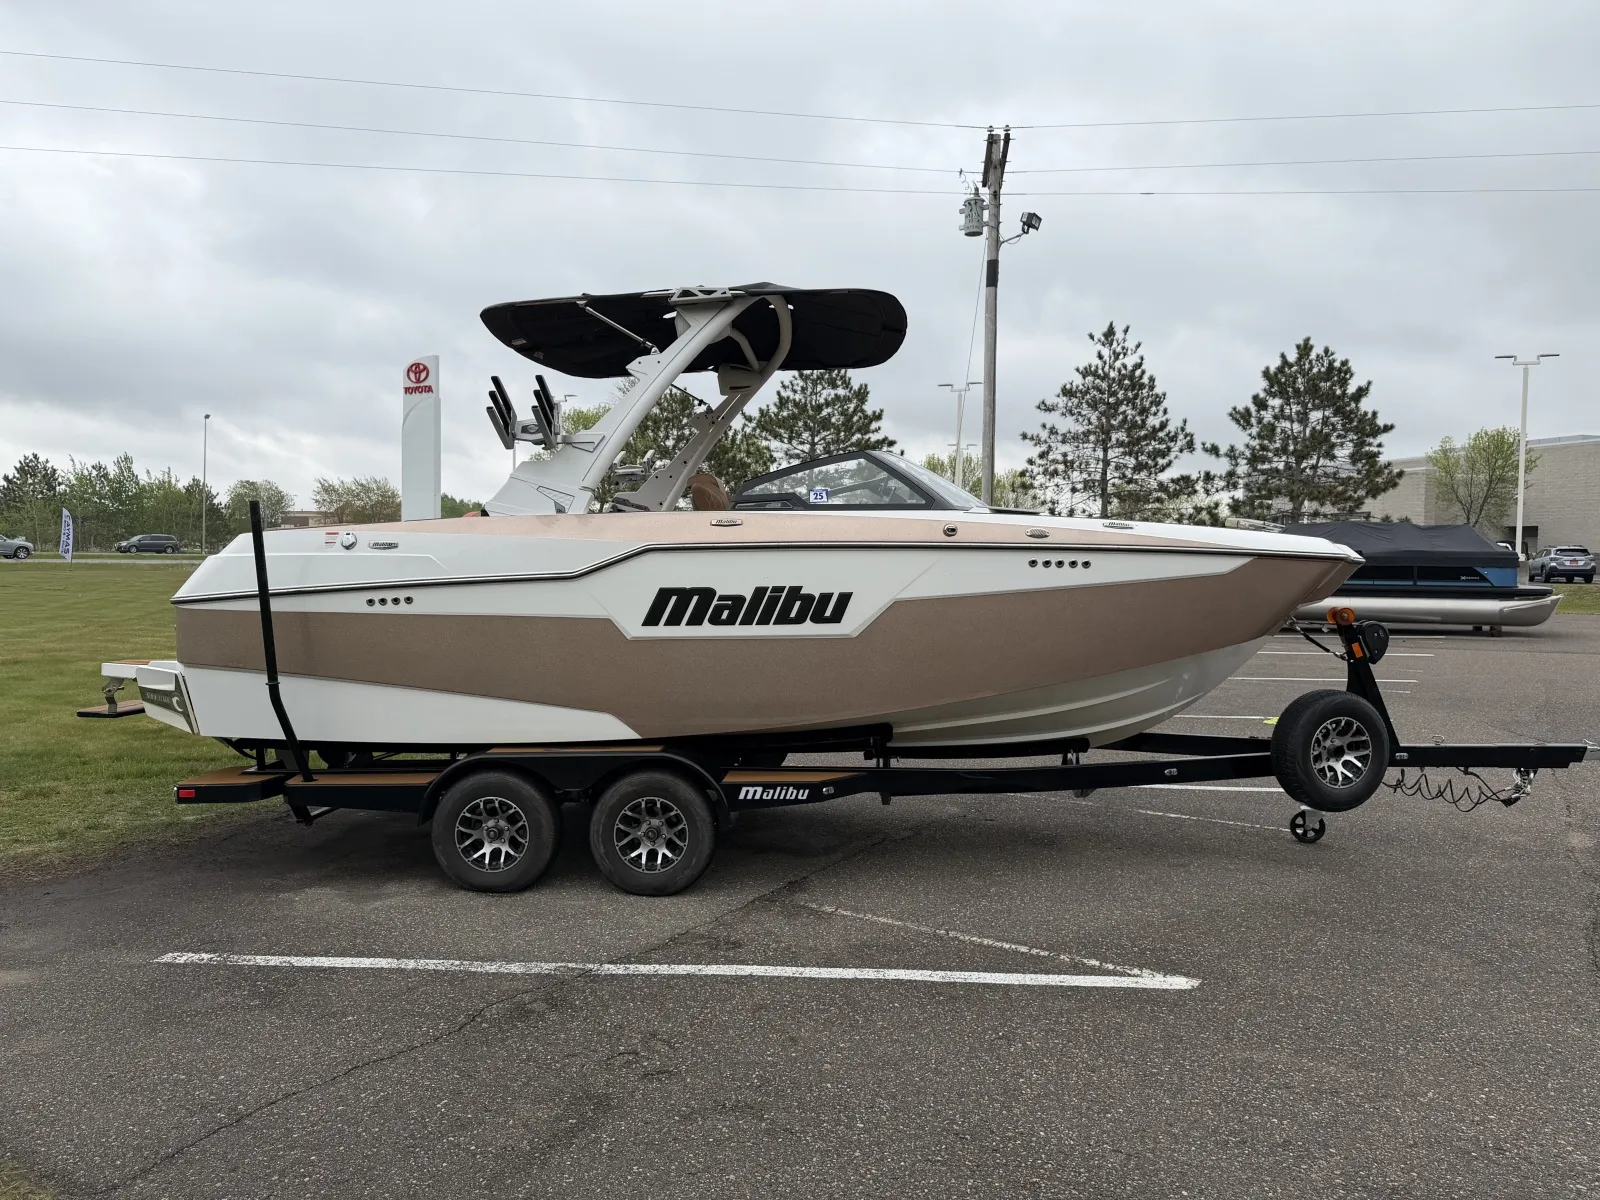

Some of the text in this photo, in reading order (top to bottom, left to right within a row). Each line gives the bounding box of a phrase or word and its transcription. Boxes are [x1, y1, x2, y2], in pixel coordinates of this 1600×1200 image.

[403, 385, 433, 395] TOYOTA
[813, 492, 824, 501] 25
[641, 586, 853, 626] Malibu
[738, 786, 809, 800] Malibu
